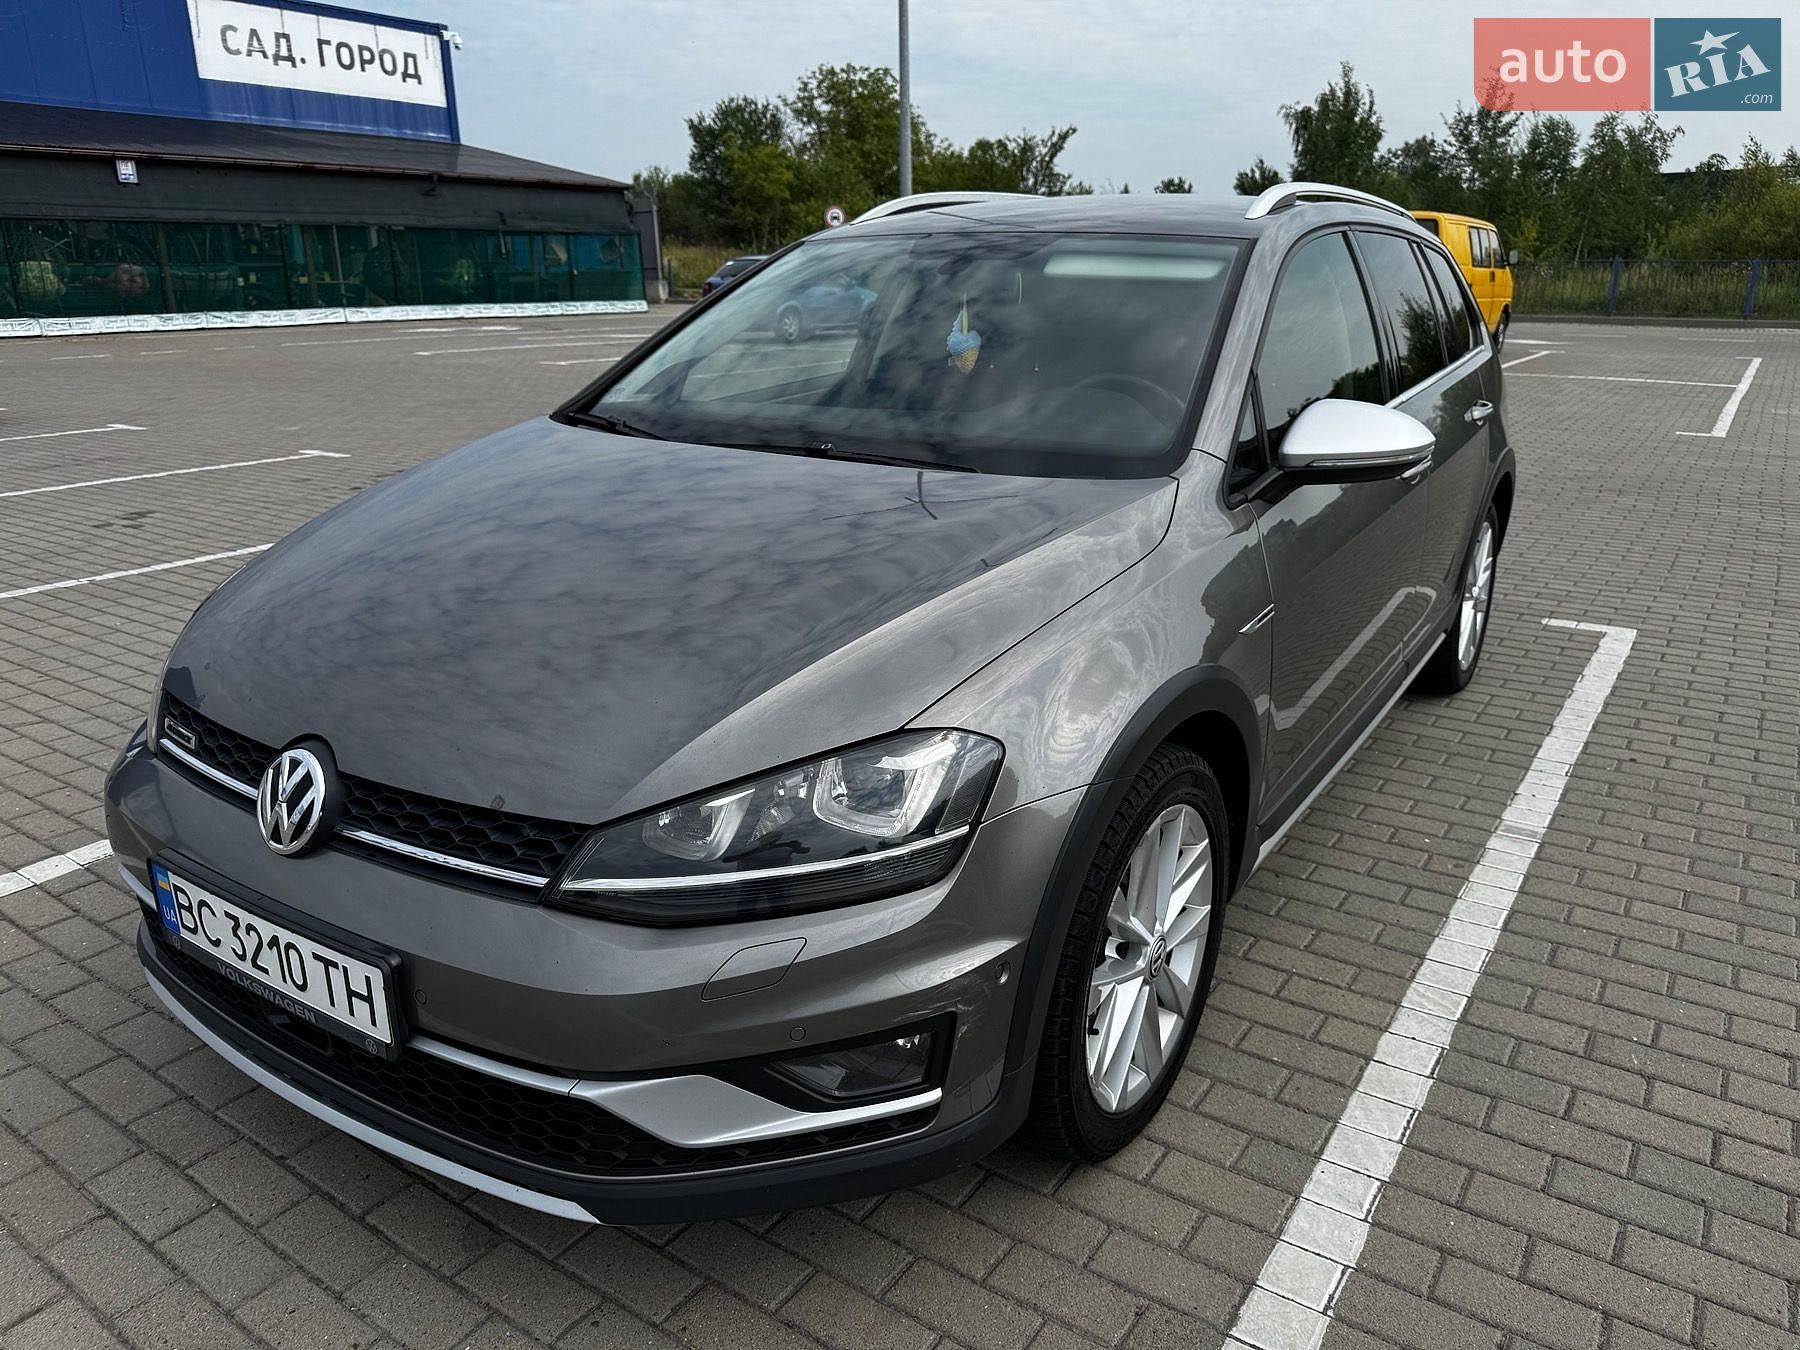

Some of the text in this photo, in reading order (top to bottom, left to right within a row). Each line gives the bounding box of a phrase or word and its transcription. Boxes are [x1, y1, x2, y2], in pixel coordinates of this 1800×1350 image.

[220, 24, 422, 85] САД. ГОРОД
[162, 907, 177, 925] UA
[172, 882, 377, 1028] BC 3210 TH
[216, 962, 316, 1025] VOLKSWAGEN
